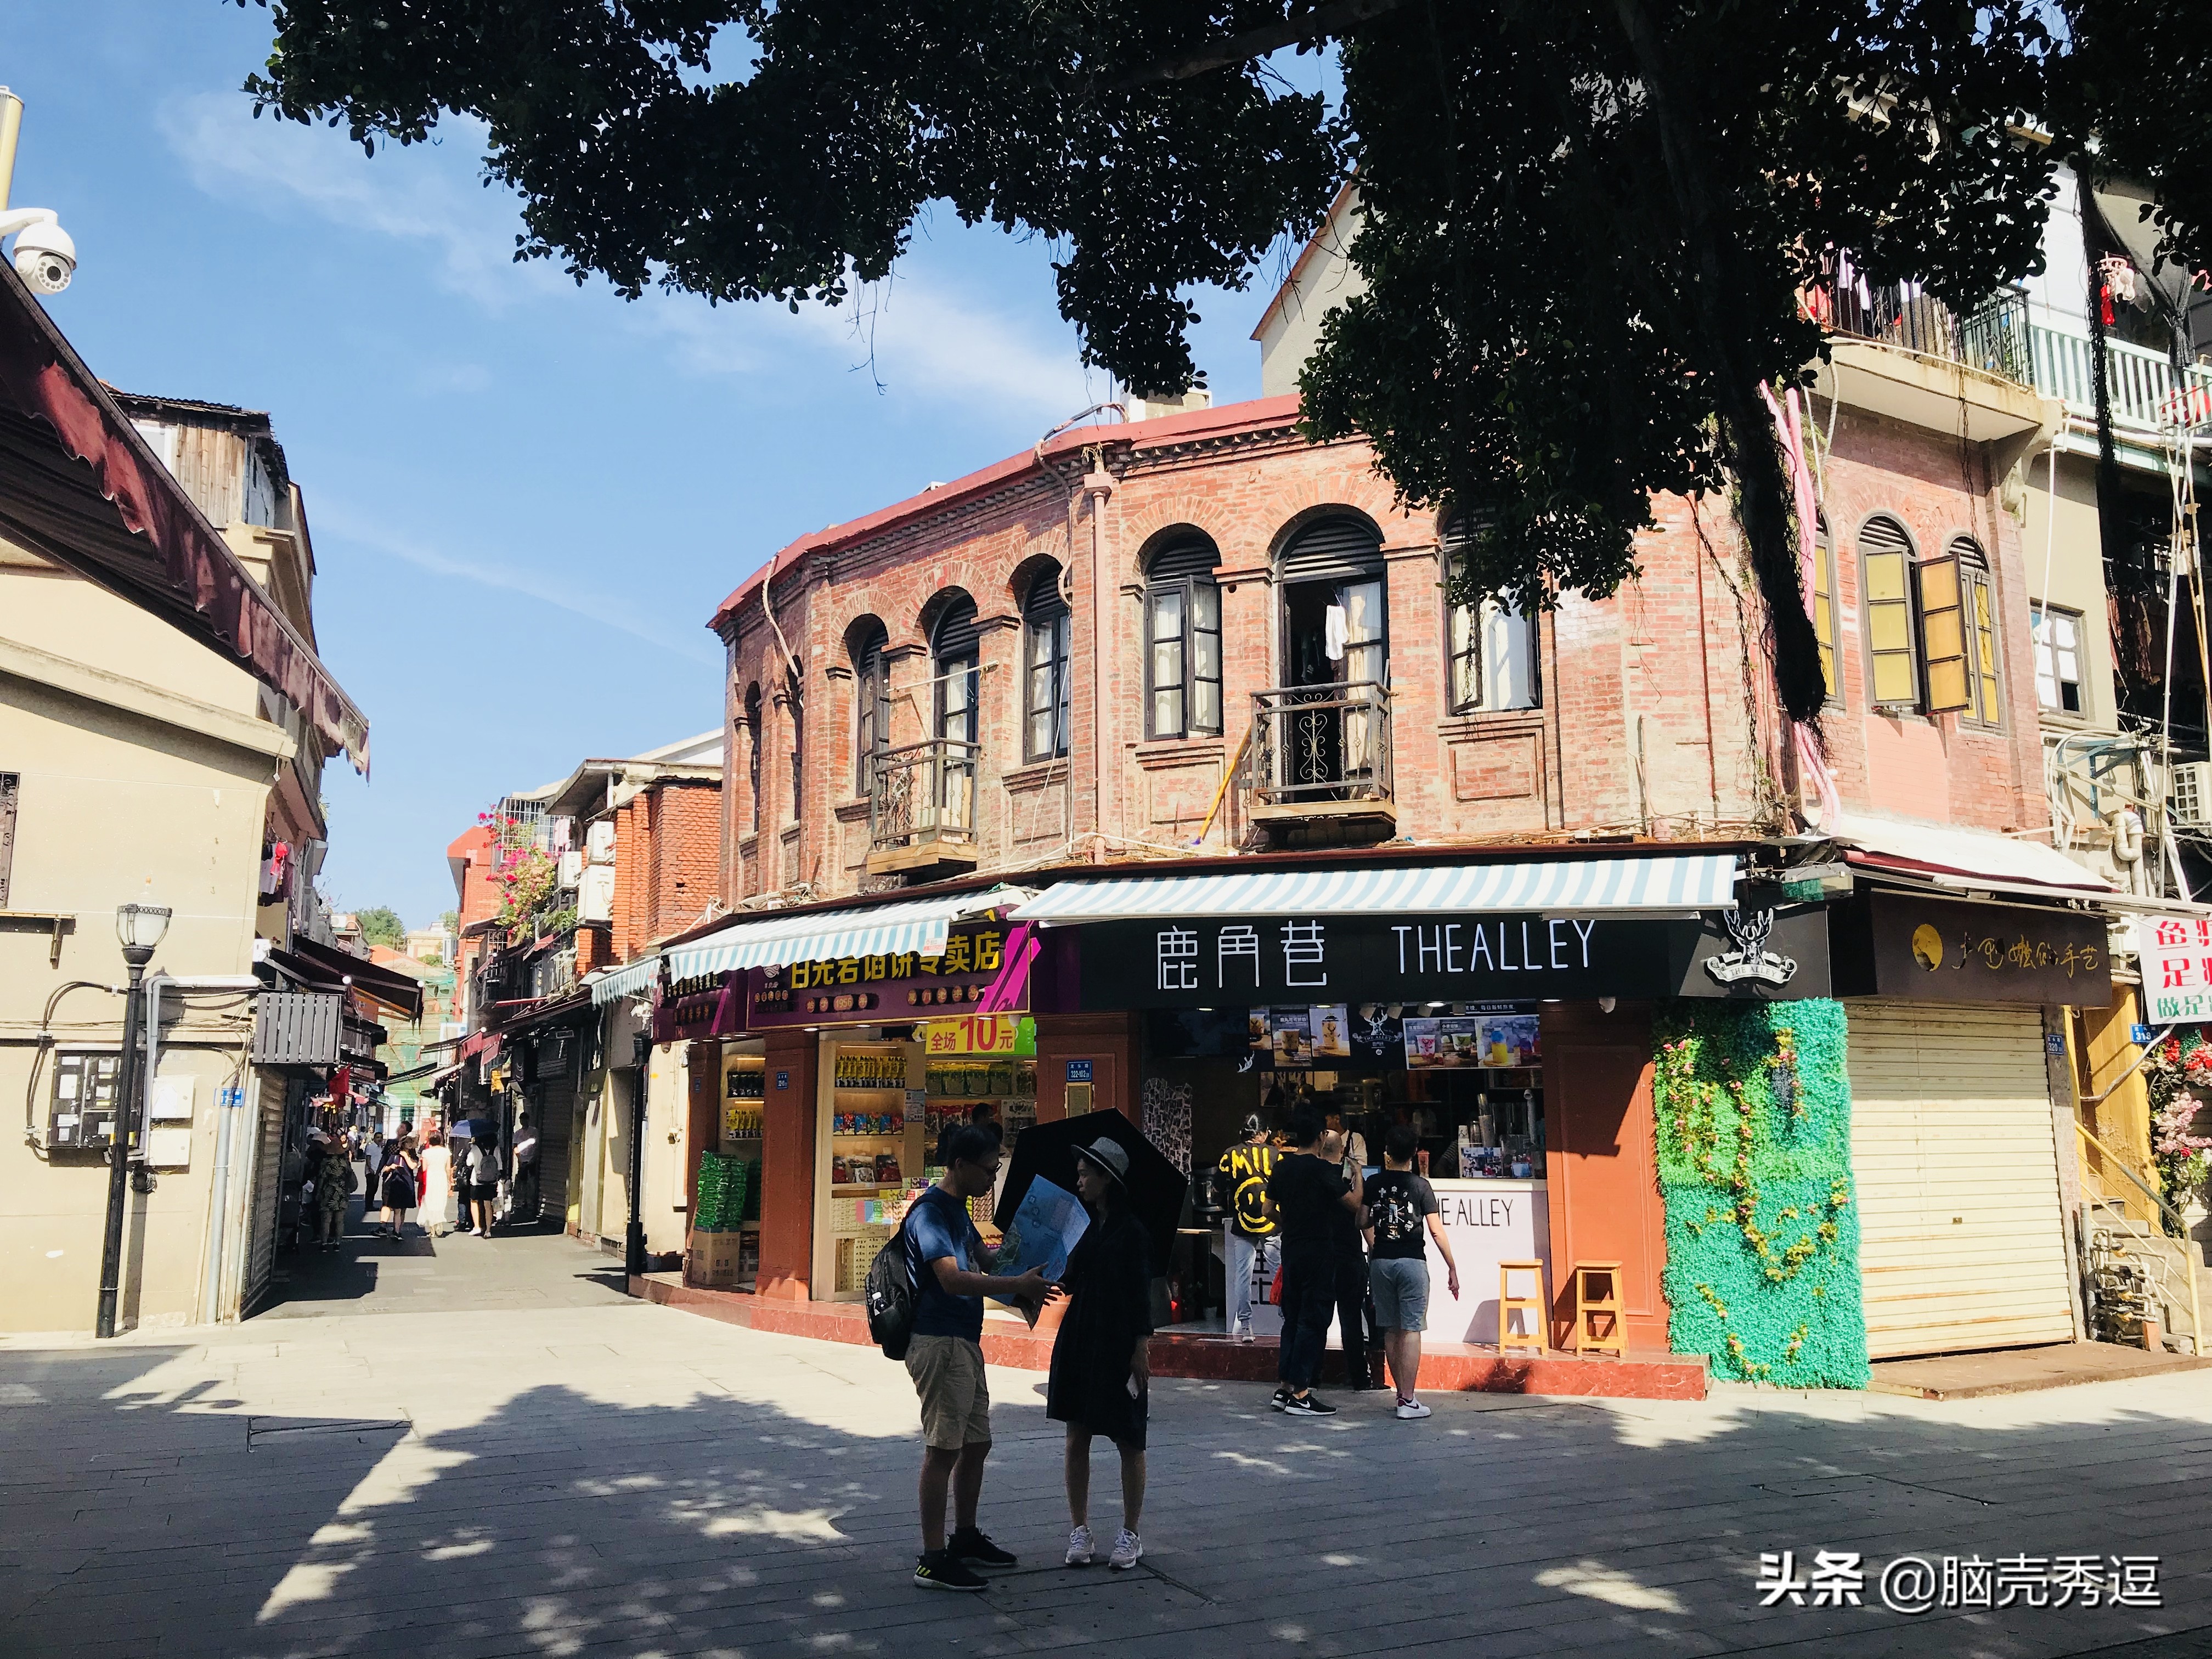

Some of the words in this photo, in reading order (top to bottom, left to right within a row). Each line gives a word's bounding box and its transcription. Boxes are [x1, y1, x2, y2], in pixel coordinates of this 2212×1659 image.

[1157, 919, 1327, 990] 鹿角巷
[1729, 967, 1747, 976] THE
[1750, 966, 1777, 978] ALLEY
[2157, 995, 2212, 1018] 做足
[1457, 1199, 1513, 1227] ALLEY
